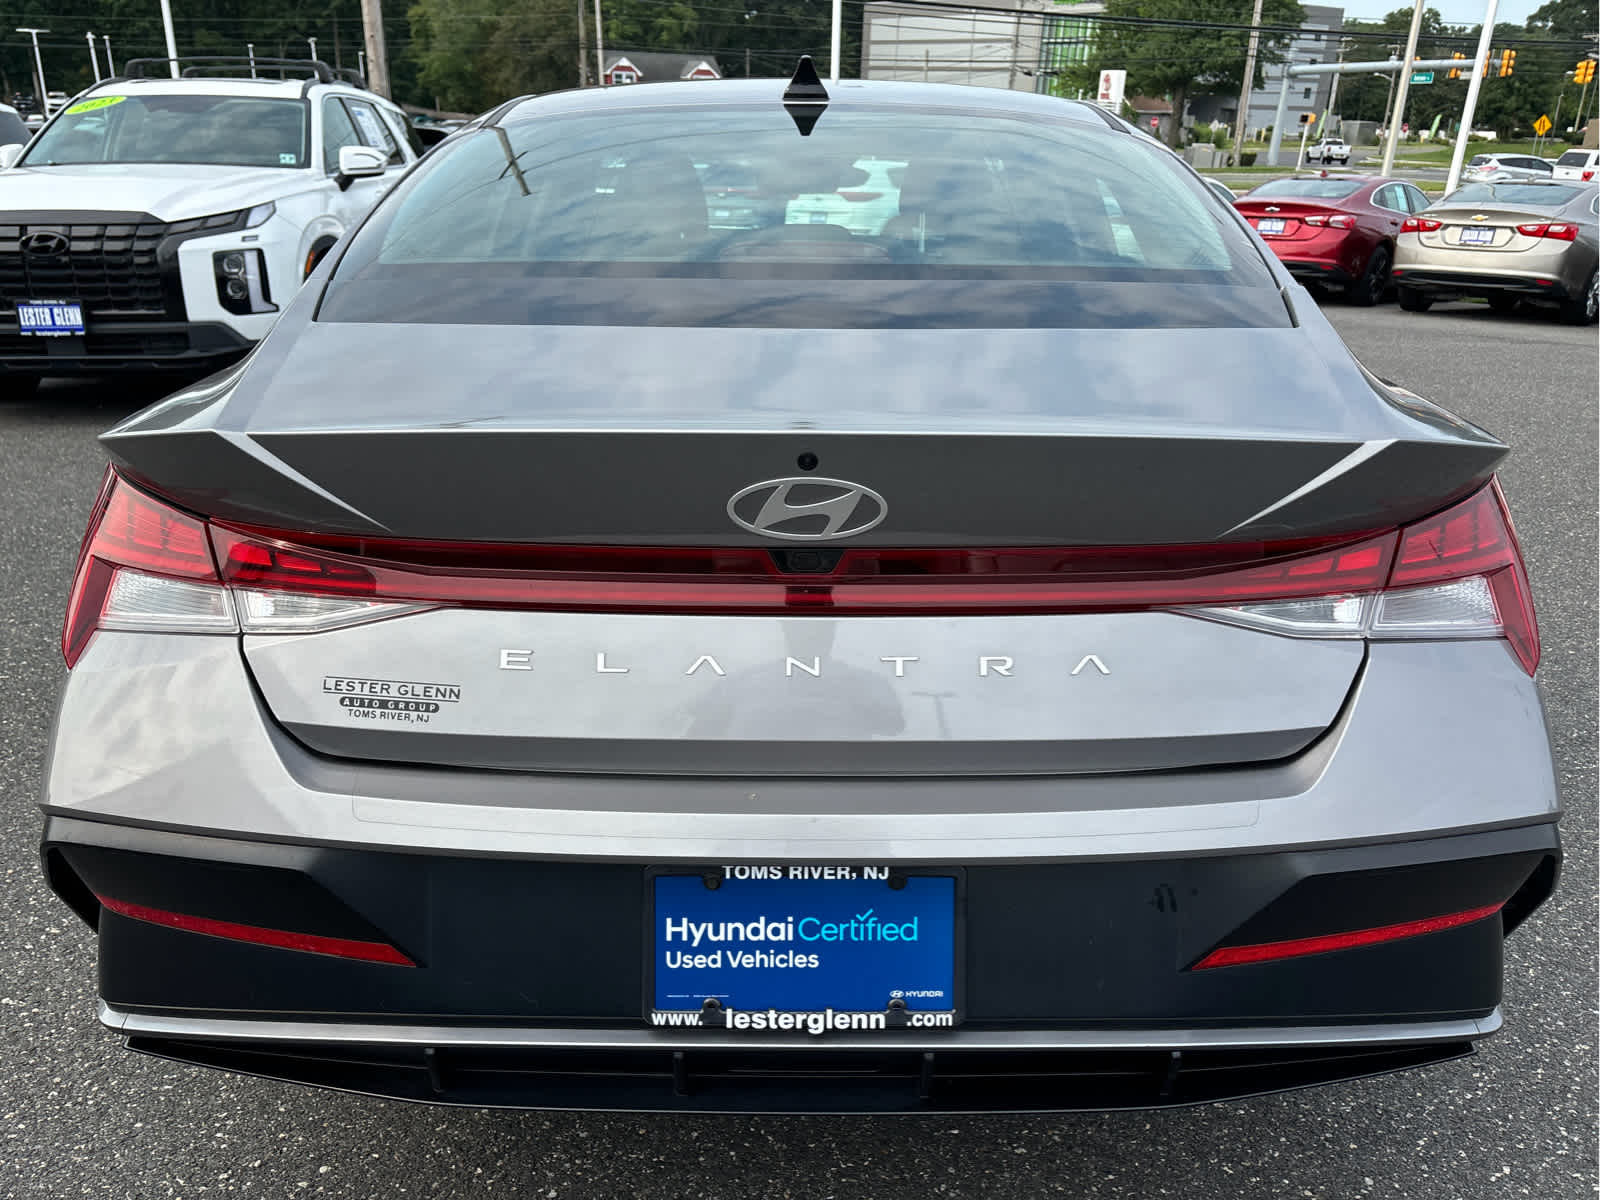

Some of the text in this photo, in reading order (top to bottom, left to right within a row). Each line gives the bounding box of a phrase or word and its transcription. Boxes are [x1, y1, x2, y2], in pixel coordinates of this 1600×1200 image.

[18, 307, 83, 325] LESTER GLENN
[499, 649, 1112, 678] ELANTRA
[323, 679, 461, 699] LESTER GLENN
[343, 698, 436, 712] AUTO GROUP
[348, 709, 430, 723] TOMS RIVER, NJ
[722, 865, 889, 880] TOMS RIVER, NJ
[665, 908, 919, 947] Hyundai Certified
[665, 949, 820, 969] Used Vehicles
[905, 990, 944, 998] HYUNDAI
[651, 1008, 953, 1034] www. lesterglenn .com
